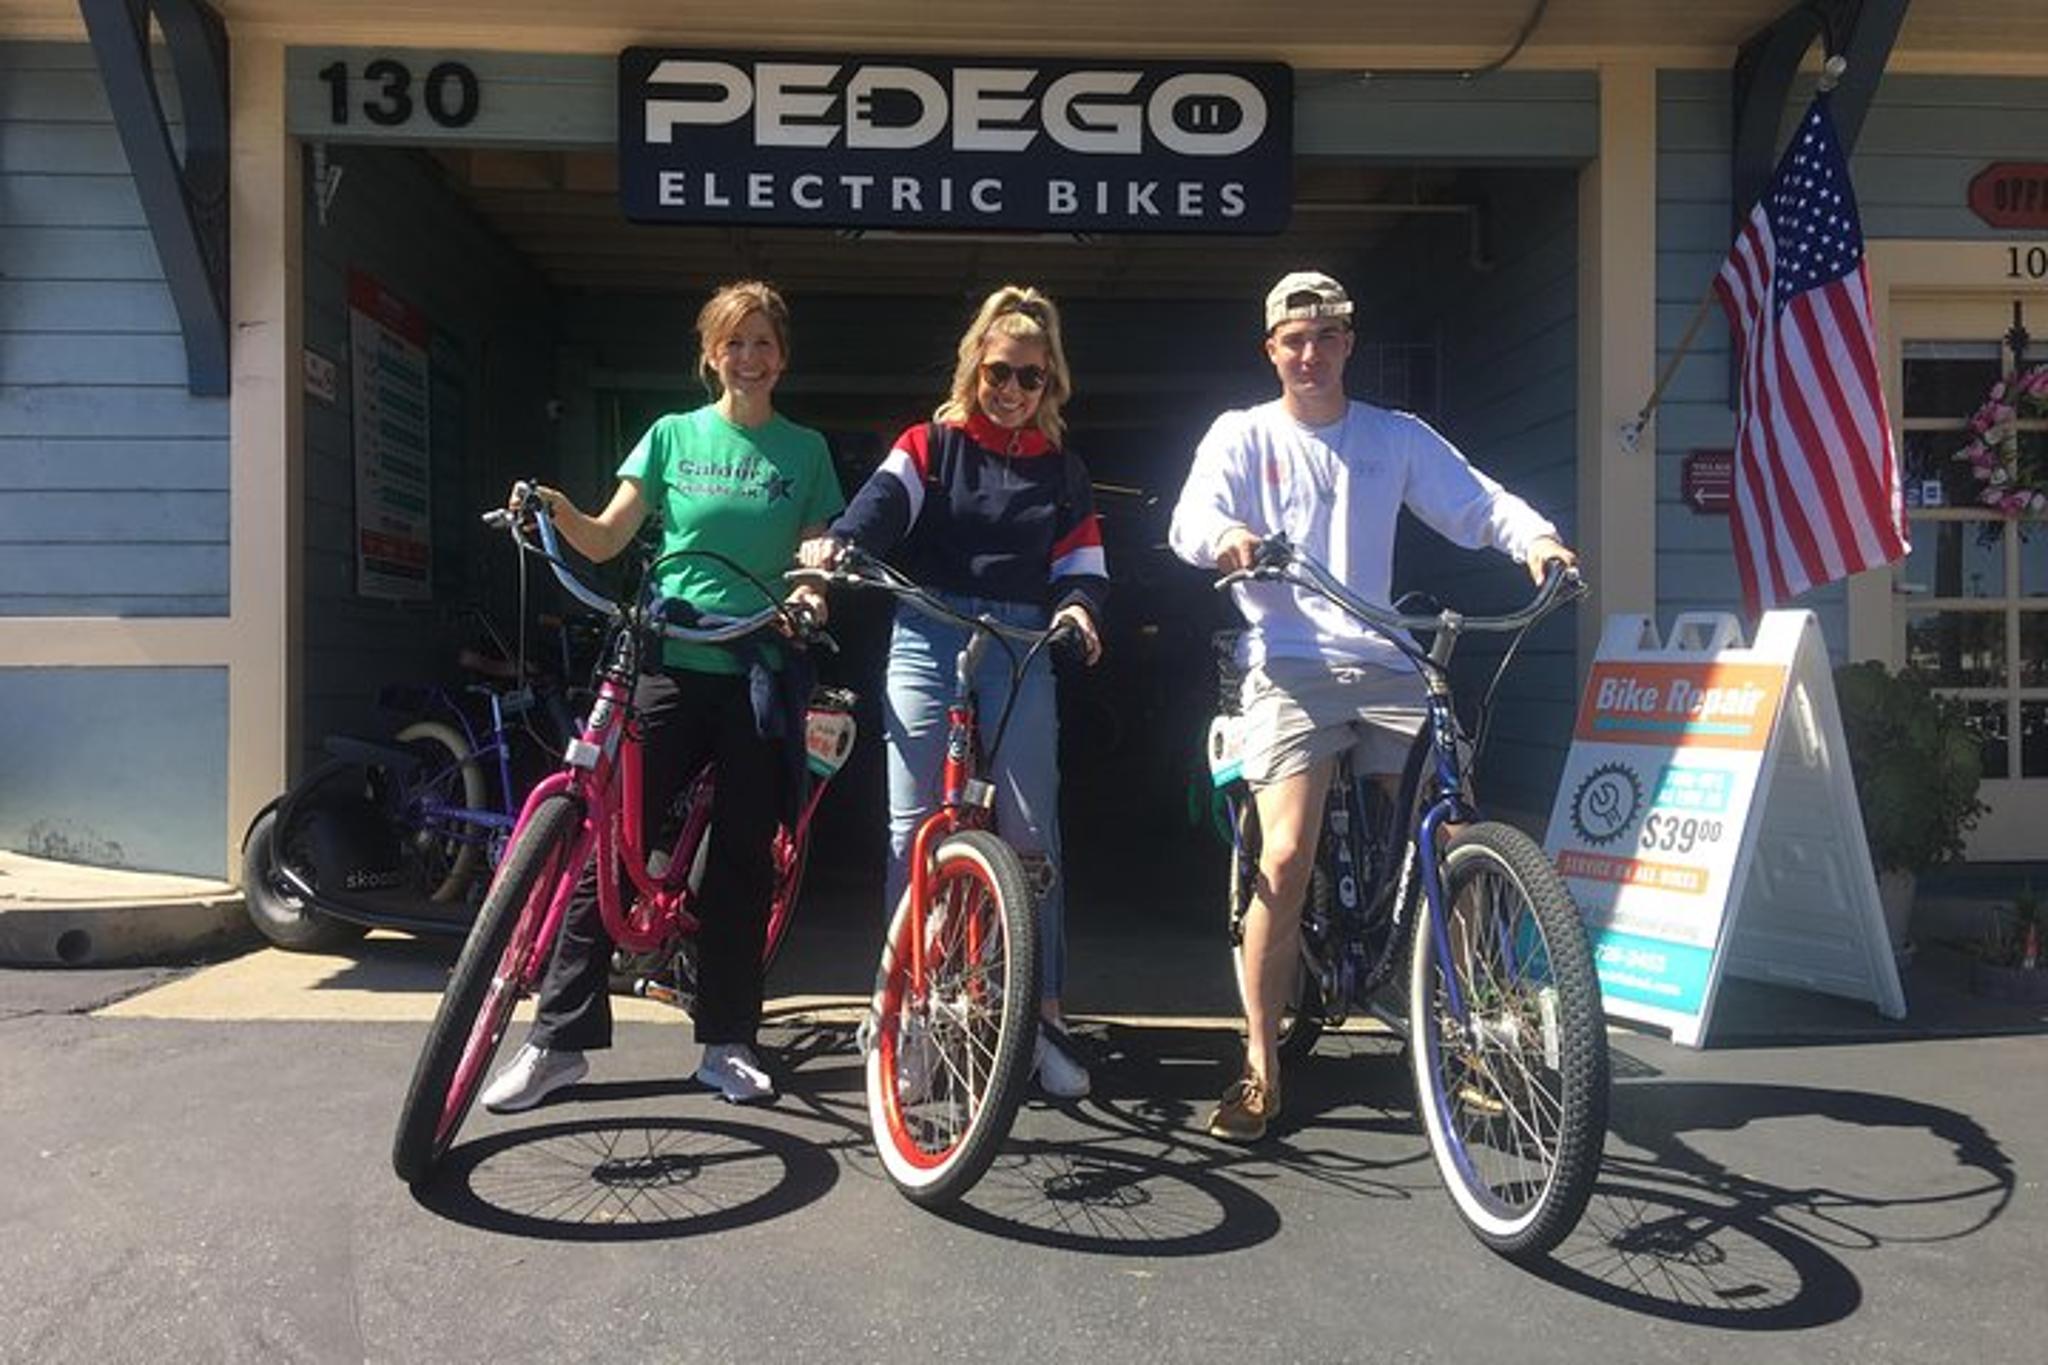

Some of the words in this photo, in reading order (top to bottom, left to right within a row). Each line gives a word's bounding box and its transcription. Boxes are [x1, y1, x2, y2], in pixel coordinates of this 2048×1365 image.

[319, 60, 480, 128] 130
[644, 59, 1269, 155] PEDEGO
[659, 171, 1003, 213] ELECTRIC
[1047, 180, 1246, 217] BIKES
[1596, 679, 1659, 711] Bike
[1667, 680, 1766, 719] Repair
